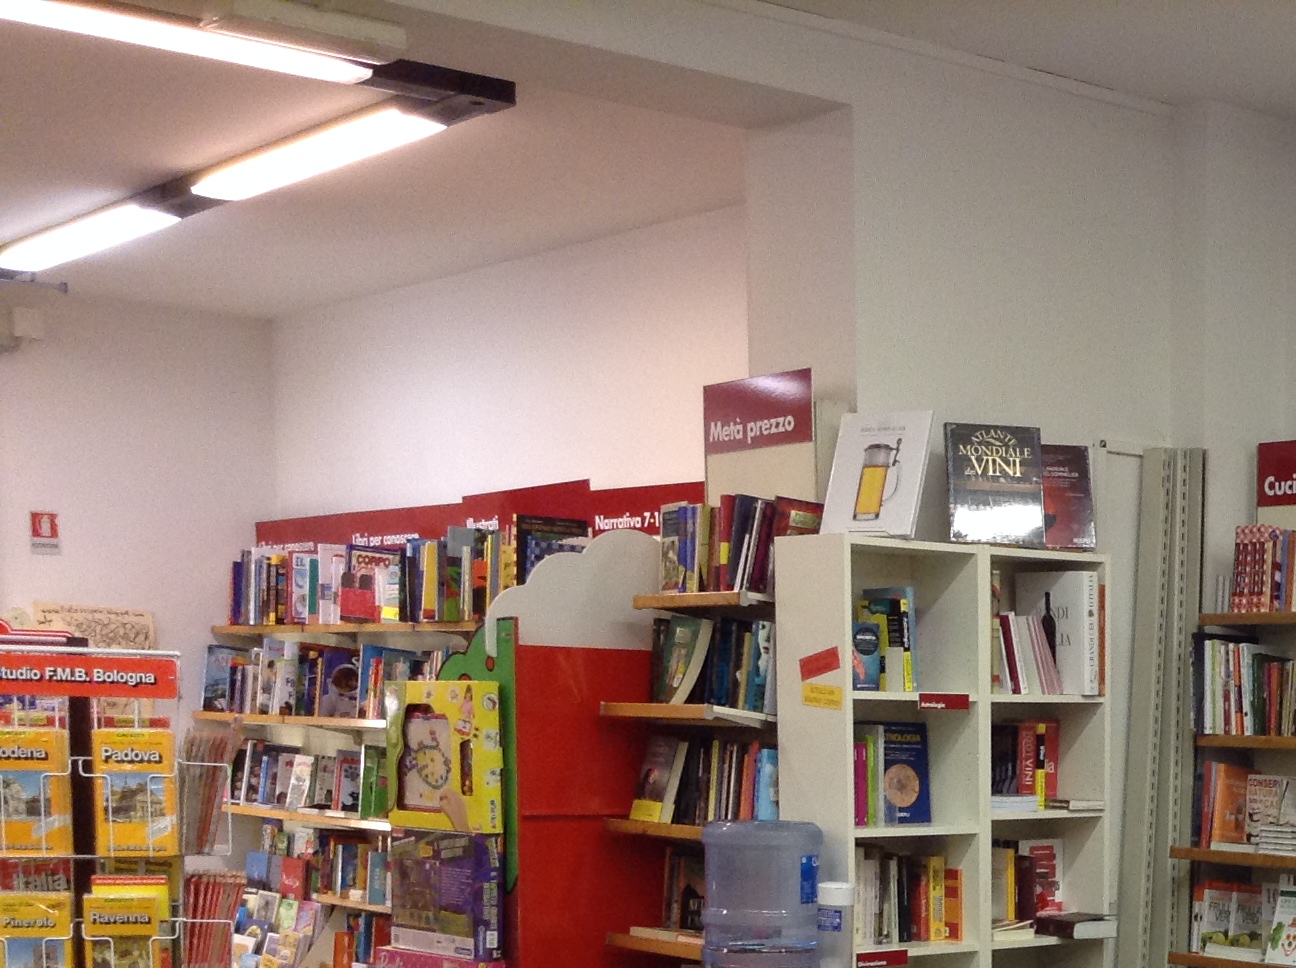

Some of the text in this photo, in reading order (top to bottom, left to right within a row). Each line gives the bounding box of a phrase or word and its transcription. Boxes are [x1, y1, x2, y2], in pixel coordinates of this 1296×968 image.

[709, 415, 795, 444] Metà prezzo
[970, 428, 1017, 447] ATLANTE
[959, 444, 1033, 459] MONDIALE
[970, 456, 1023, 477] VINI
[595, 512, 642, 531] Narrativa
[352, 533, 369, 546] Libri
[369, 534, 382, 548] per
[356, 553, 390, 568] CORPO
[45, 667, 91, 682] F.M.B.
[93, 668, 156, 684] Bologna
[884, 733, 921, 743] TROLOGIA
[0, 745, 46, 759] odena
[101, 746, 161, 762] Padova
[1022, 758, 1036, 785] VINI
[1248, 777, 1279, 789] CONSER
[3, 917, 56, 930] Pinerolo
[89, 911, 150, 925] Ravenna
